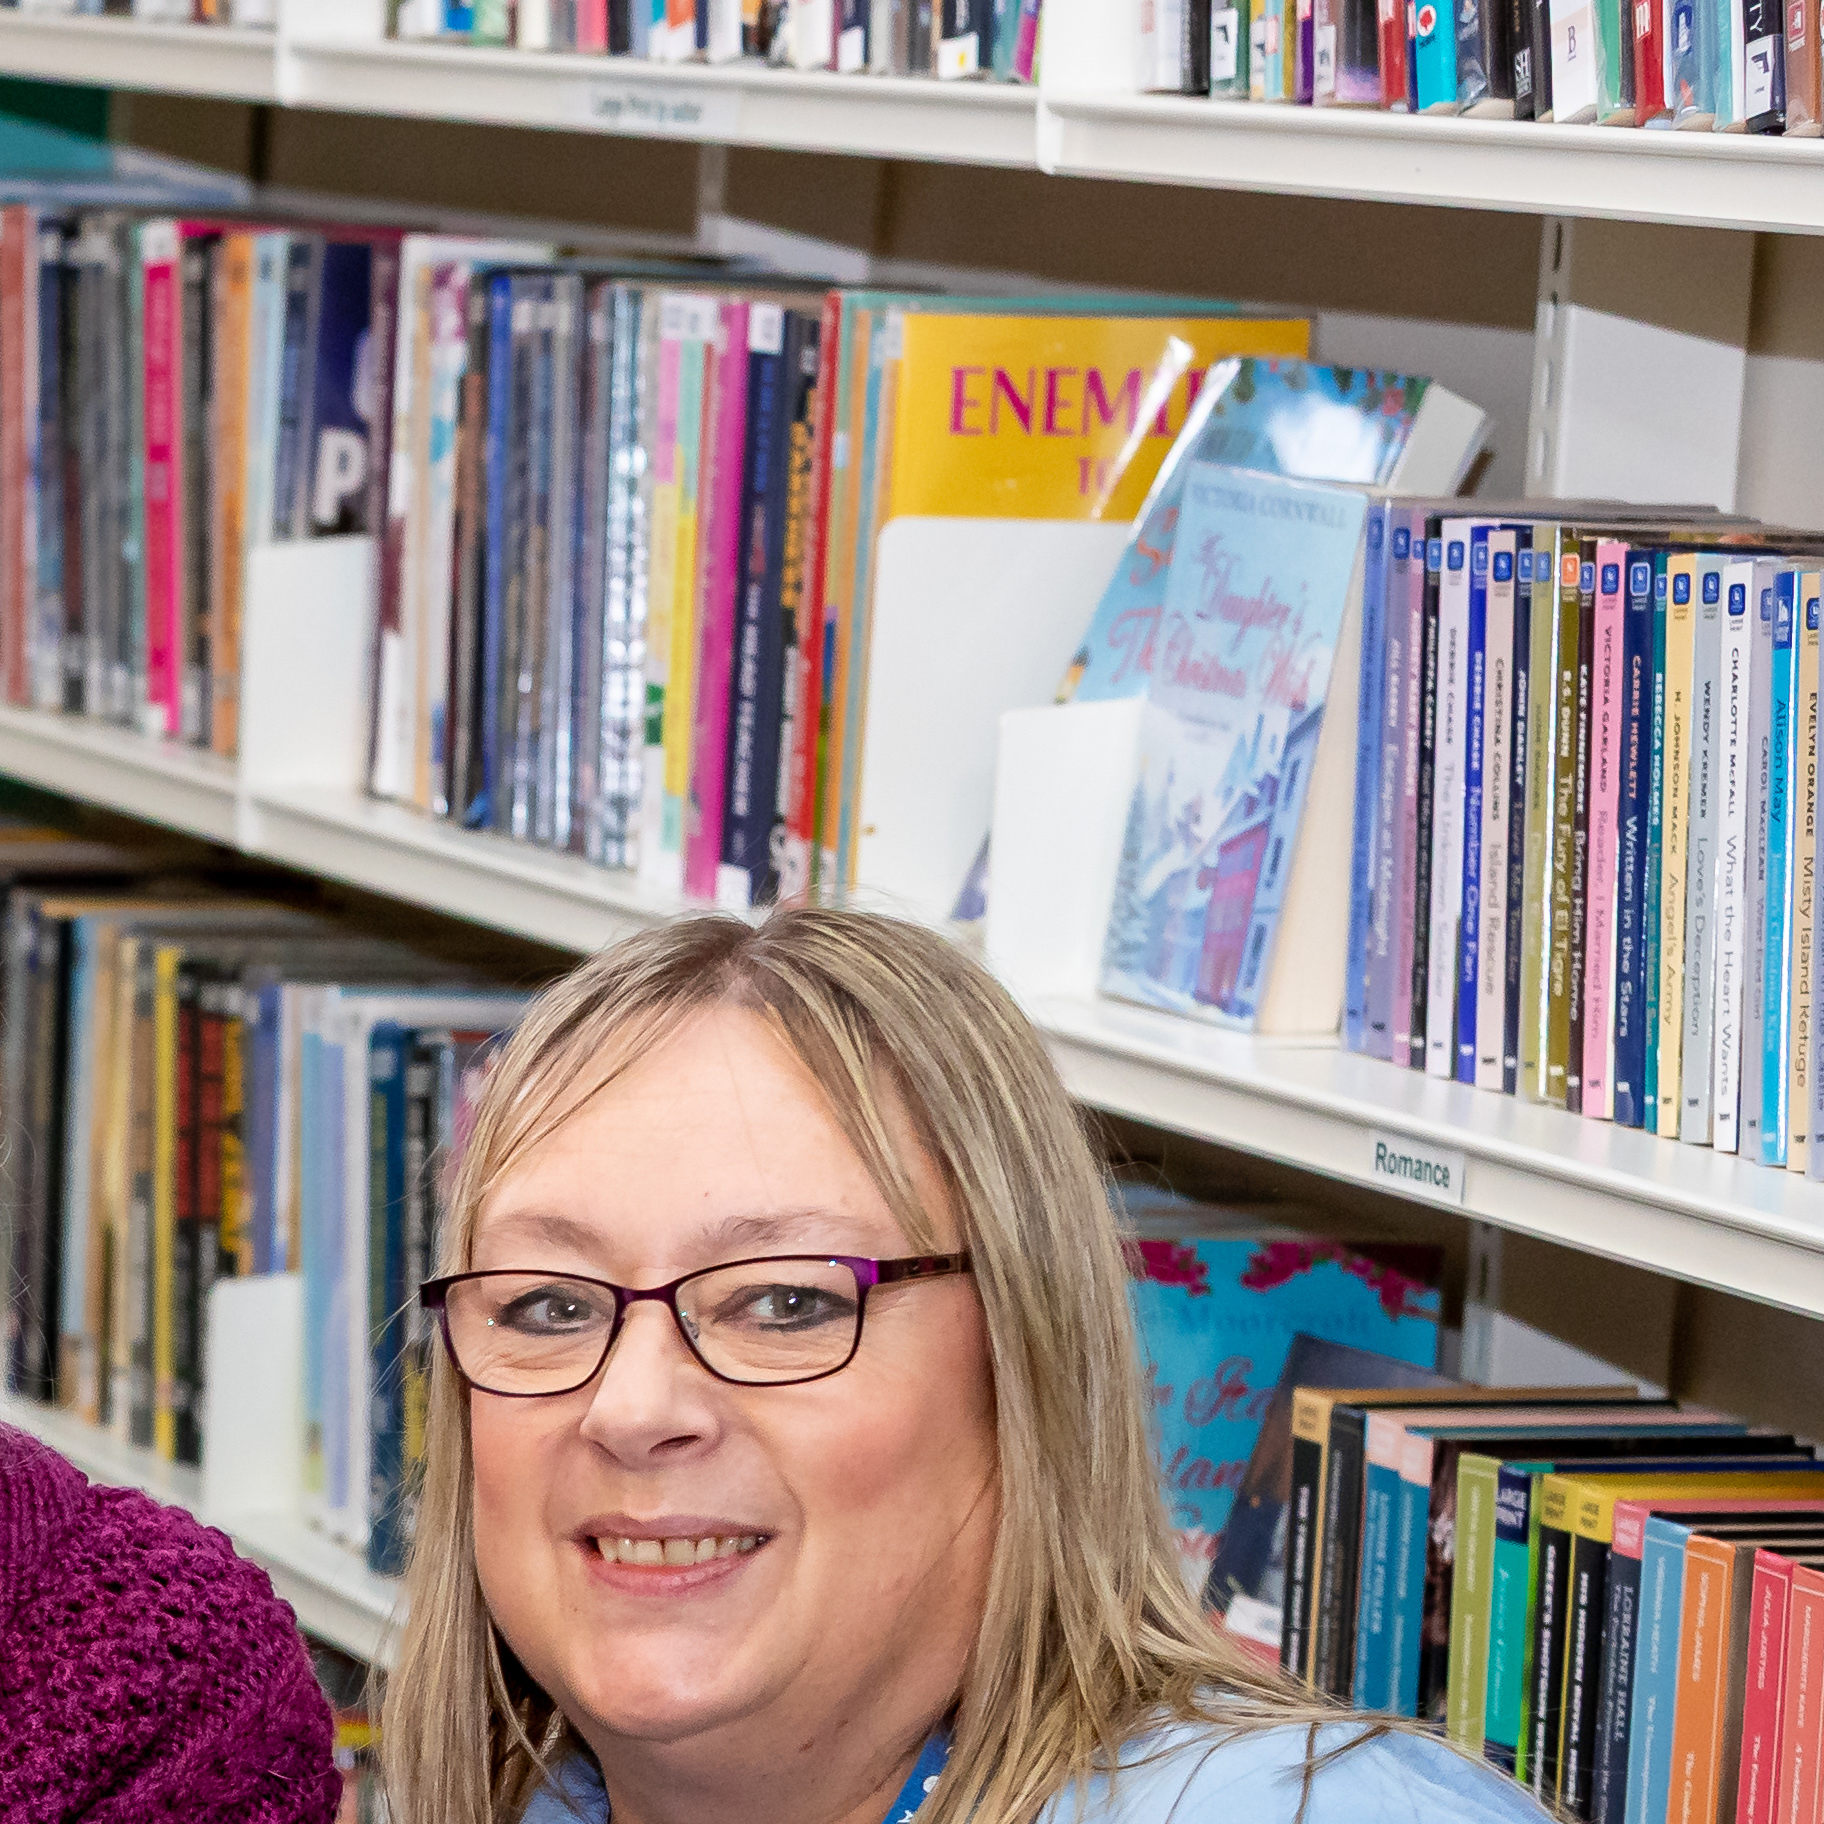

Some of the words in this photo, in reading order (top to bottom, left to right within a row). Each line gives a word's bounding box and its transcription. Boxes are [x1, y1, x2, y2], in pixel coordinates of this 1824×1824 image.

[1579, 664, 1588, 708] KATE
[1601, 625, 1613, 706] VICTORIA
[1629, 654, 1642, 717] CARRIE
[1729, 646, 1740, 747] CHARLOTTE
[1493, 658, 1505, 747] CHRISTINA
[1559, 706, 1571, 758] DUNN
[1653, 672, 1664, 750] REBECCA
[1702, 680, 1712, 745] WENDY
[1773, 699, 1787, 769] Alison
[1808, 692, 1819, 757] EVELYN
[1576, 711, 1587, 815] FINNEMORE
[1598, 711, 1611, 793] GARLAND
[1627, 720, 1640, 801] HEWLETT
[1671, 714, 1681, 799] JOHNSON
[1699, 748, 1709, 819] KREMER
[1759, 735, 1768, 793] CAROL
[1557, 771, 1573, 818] The
[1651, 753, 1662, 827] HOLMES
[1727, 753, 1737, 818] McFALL
[1770, 775, 1785, 823] May
[1805, 762, 1816, 839] ORANGE
[1467, 786, 1482, 879] Number
[1554, 823, 1572, 873] Fury
[1571, 829, 1588, 892] Bring
[1622, 815, 1638, 902] Written
[1670, 802, 1679, 855] MACK
[1487, 843, 1504, 909] Island
[1555, 878, 1571, 903] of
[1693, 837, 1709, 908] Love's
[1723, 834, 1738, 898] What
[1798, 855, 1815, 919] Misty
[1465, 885, 1479, 935] One
[1554, 909, 1569, 932] El
[1571, 898, 1586, 945] Him
[1622, 908, 1636, 929] in
[1663, 872, 1679, 958] Angel's
[1722, 905, 1736, 942] the
[1484, 917, 1501, 995] Rescue
[1591, 908, 1605, 991] Married
[1620, 936, 1635, 975] the
[1689, 914, 1706, 1037] Deception
[1798, 926, 1812, 995] Island
[1569, 950, 1583, 1022] Home
[1618, 980, 1634, 1038] Stars
[1662, 963, 1677, 1027] Army
[1720, 951, 1735, 1017] Heart
[1718, 1023, 1732, 1097] Wants
[1794, 1004, 1810, 1089] Refuge
[1375, 1141, 1450, 1189] Romance
[1579, 1572, 1589, 1606] HIS
[1762, 1585, 1772, 1628] JULIA
[1618, 1585, 1635, 1683] LORRAINE
[1691, 1630, 1703, 1682] JAMES
[1799, 1604, 1812, 1691] MARGUERITE
[1614, 1688, 1630, 1743] HALL
[1646, 1695, 1657, 1724] The
[1796, 1693, 1806, 1729] KAYE
[1685, 1750, 1696, 1777] The
[1752, 1735, 1762, 1760] The
